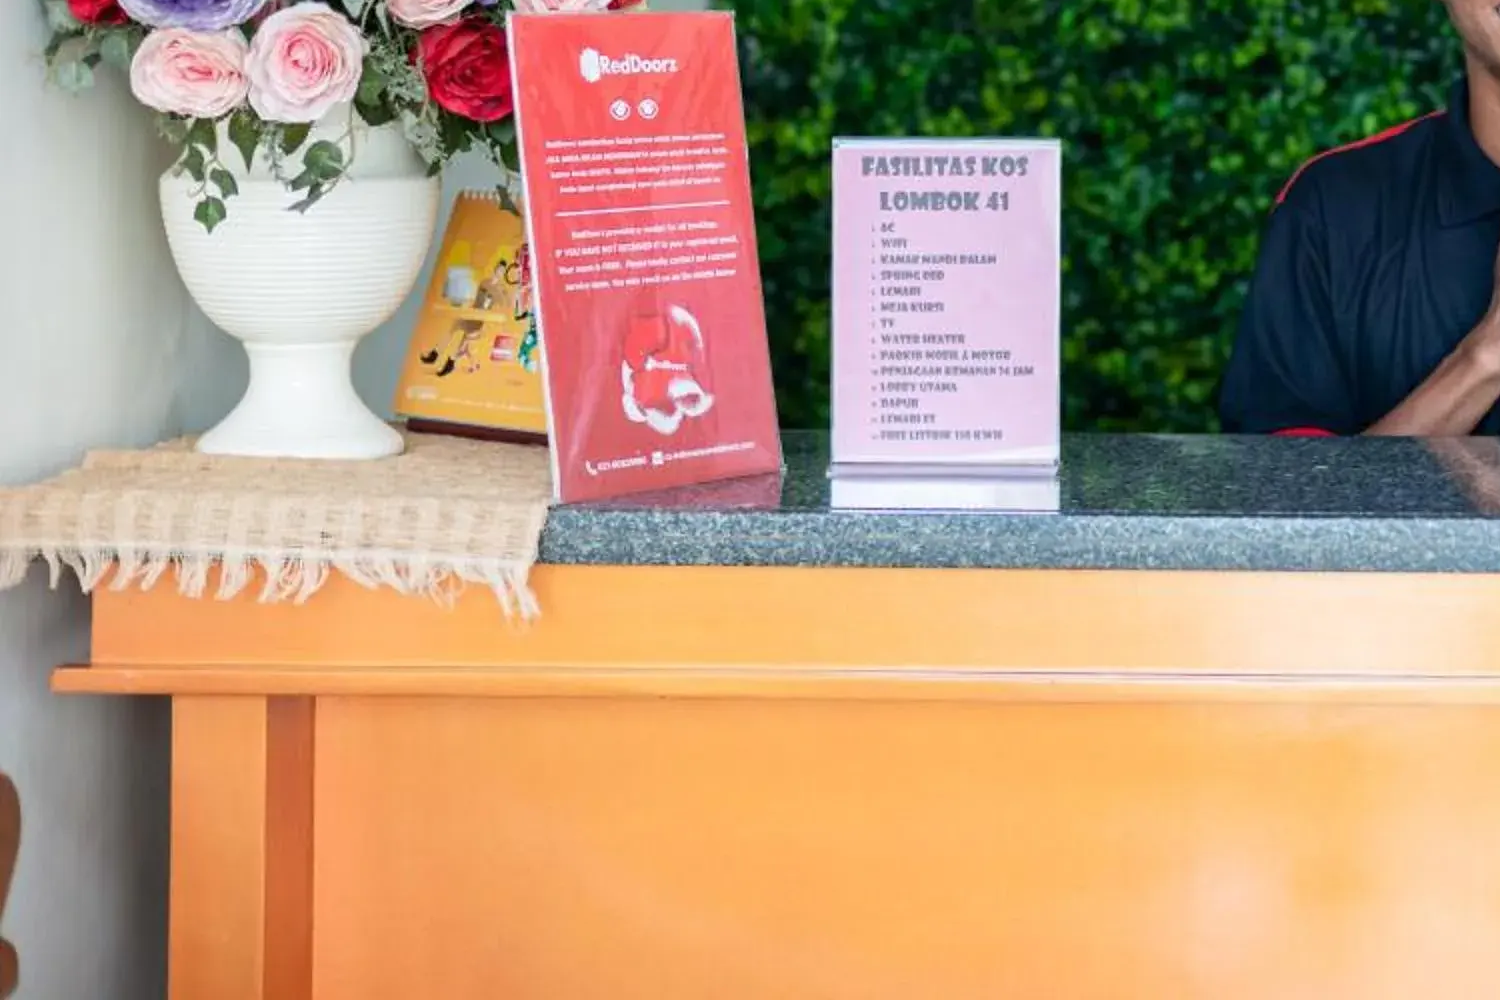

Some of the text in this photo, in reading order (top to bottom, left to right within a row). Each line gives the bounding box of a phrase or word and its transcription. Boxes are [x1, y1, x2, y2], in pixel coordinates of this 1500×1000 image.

[600, 52, 678, 74] RedDoorz
[861, 155, 1029, 177] FASILITAS KOS
[879, 191, 1009, 212] LOMBOK 41
